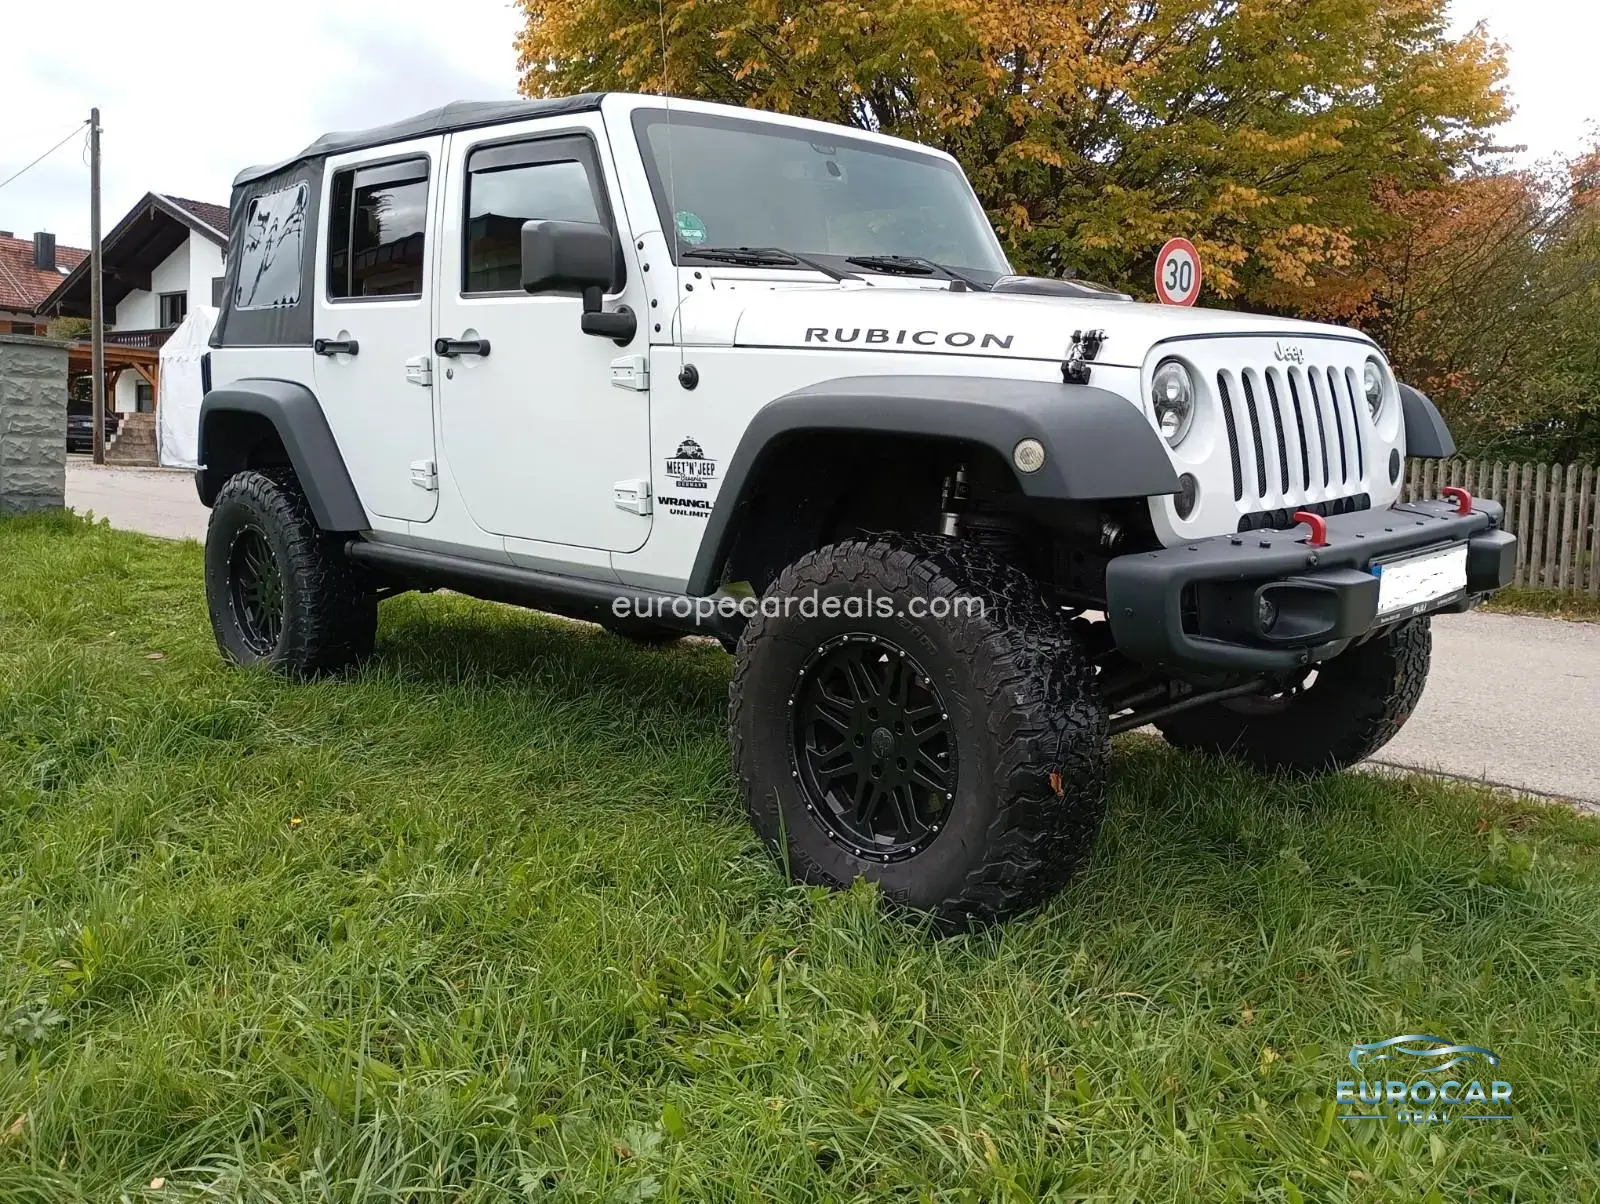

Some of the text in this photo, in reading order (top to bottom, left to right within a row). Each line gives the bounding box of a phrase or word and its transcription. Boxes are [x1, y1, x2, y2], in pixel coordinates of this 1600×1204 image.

[1165, 258, 1192, 293] 30
[804, 327, 1014, 349] RUBICON
[1273, 341, 1305, 365] Jeep
[698, 462, 715, 476] JEEP
